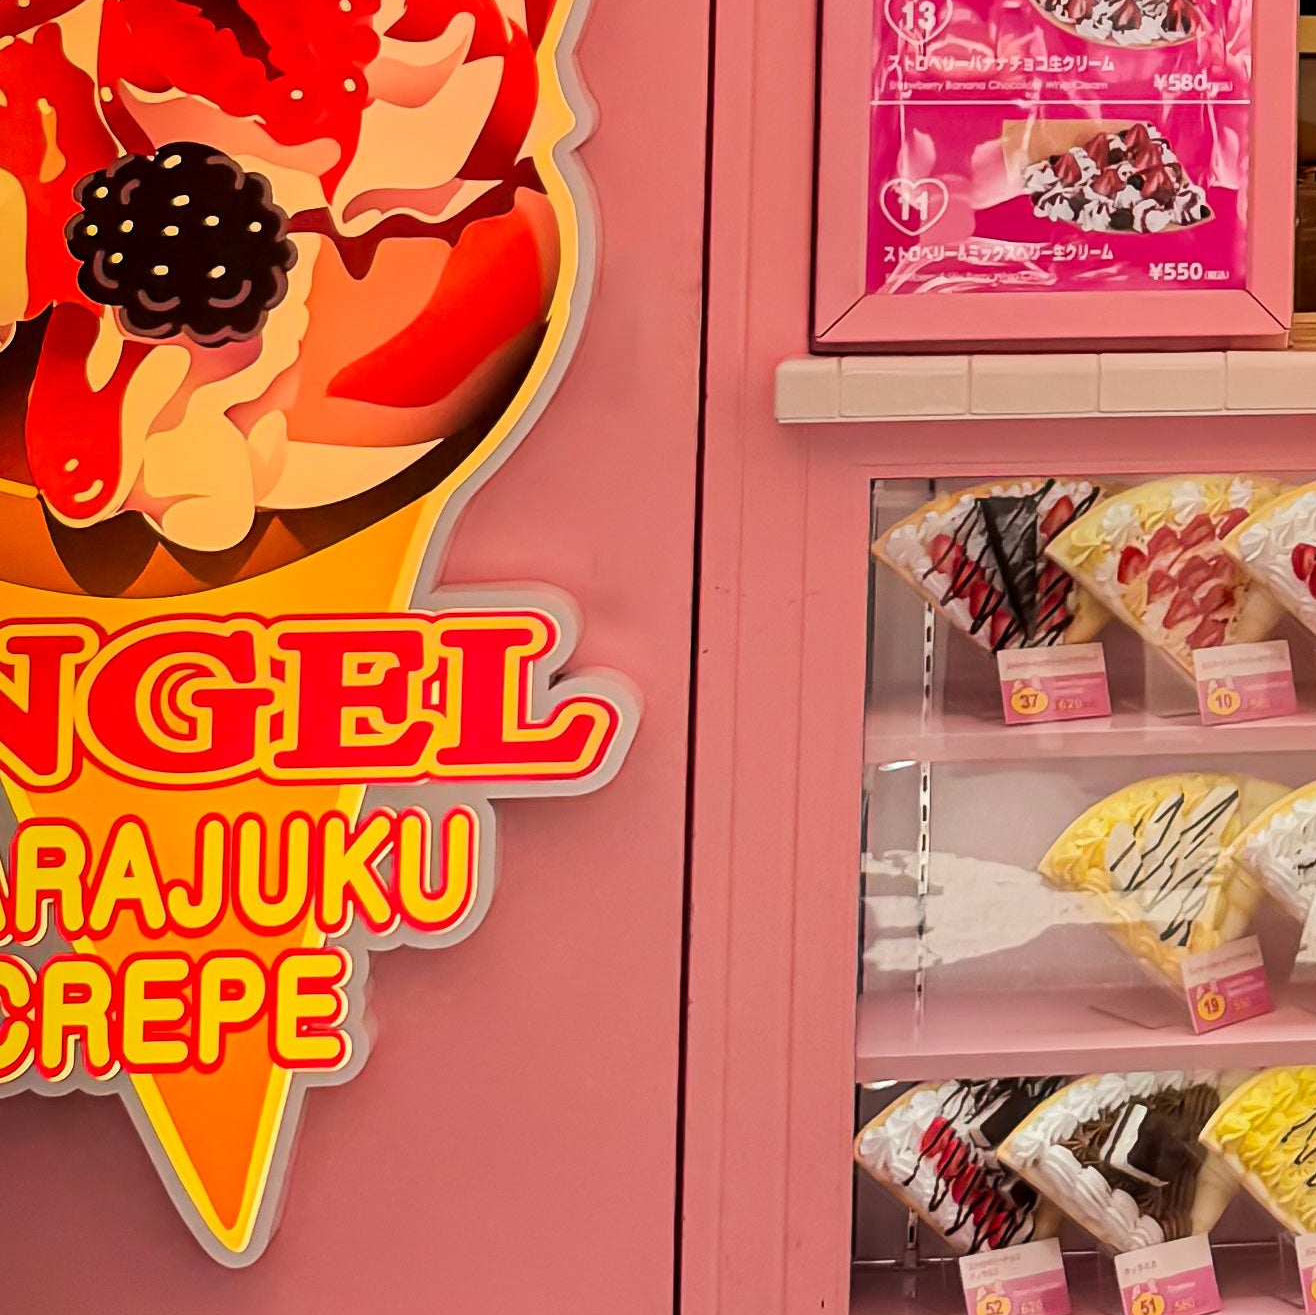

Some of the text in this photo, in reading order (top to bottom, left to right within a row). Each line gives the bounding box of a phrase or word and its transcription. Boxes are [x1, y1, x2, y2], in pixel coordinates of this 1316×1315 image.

[1149, 263, 1203, 281] ¥550
[1019, 694, 1039, 710] 37
[1215, 693, 1232, 709] 10
[0, 803, 478, 946] RAJUKU
[985, 1300, 1003, 1315] 52
[1140, 1300, 1156, 1315] 51
